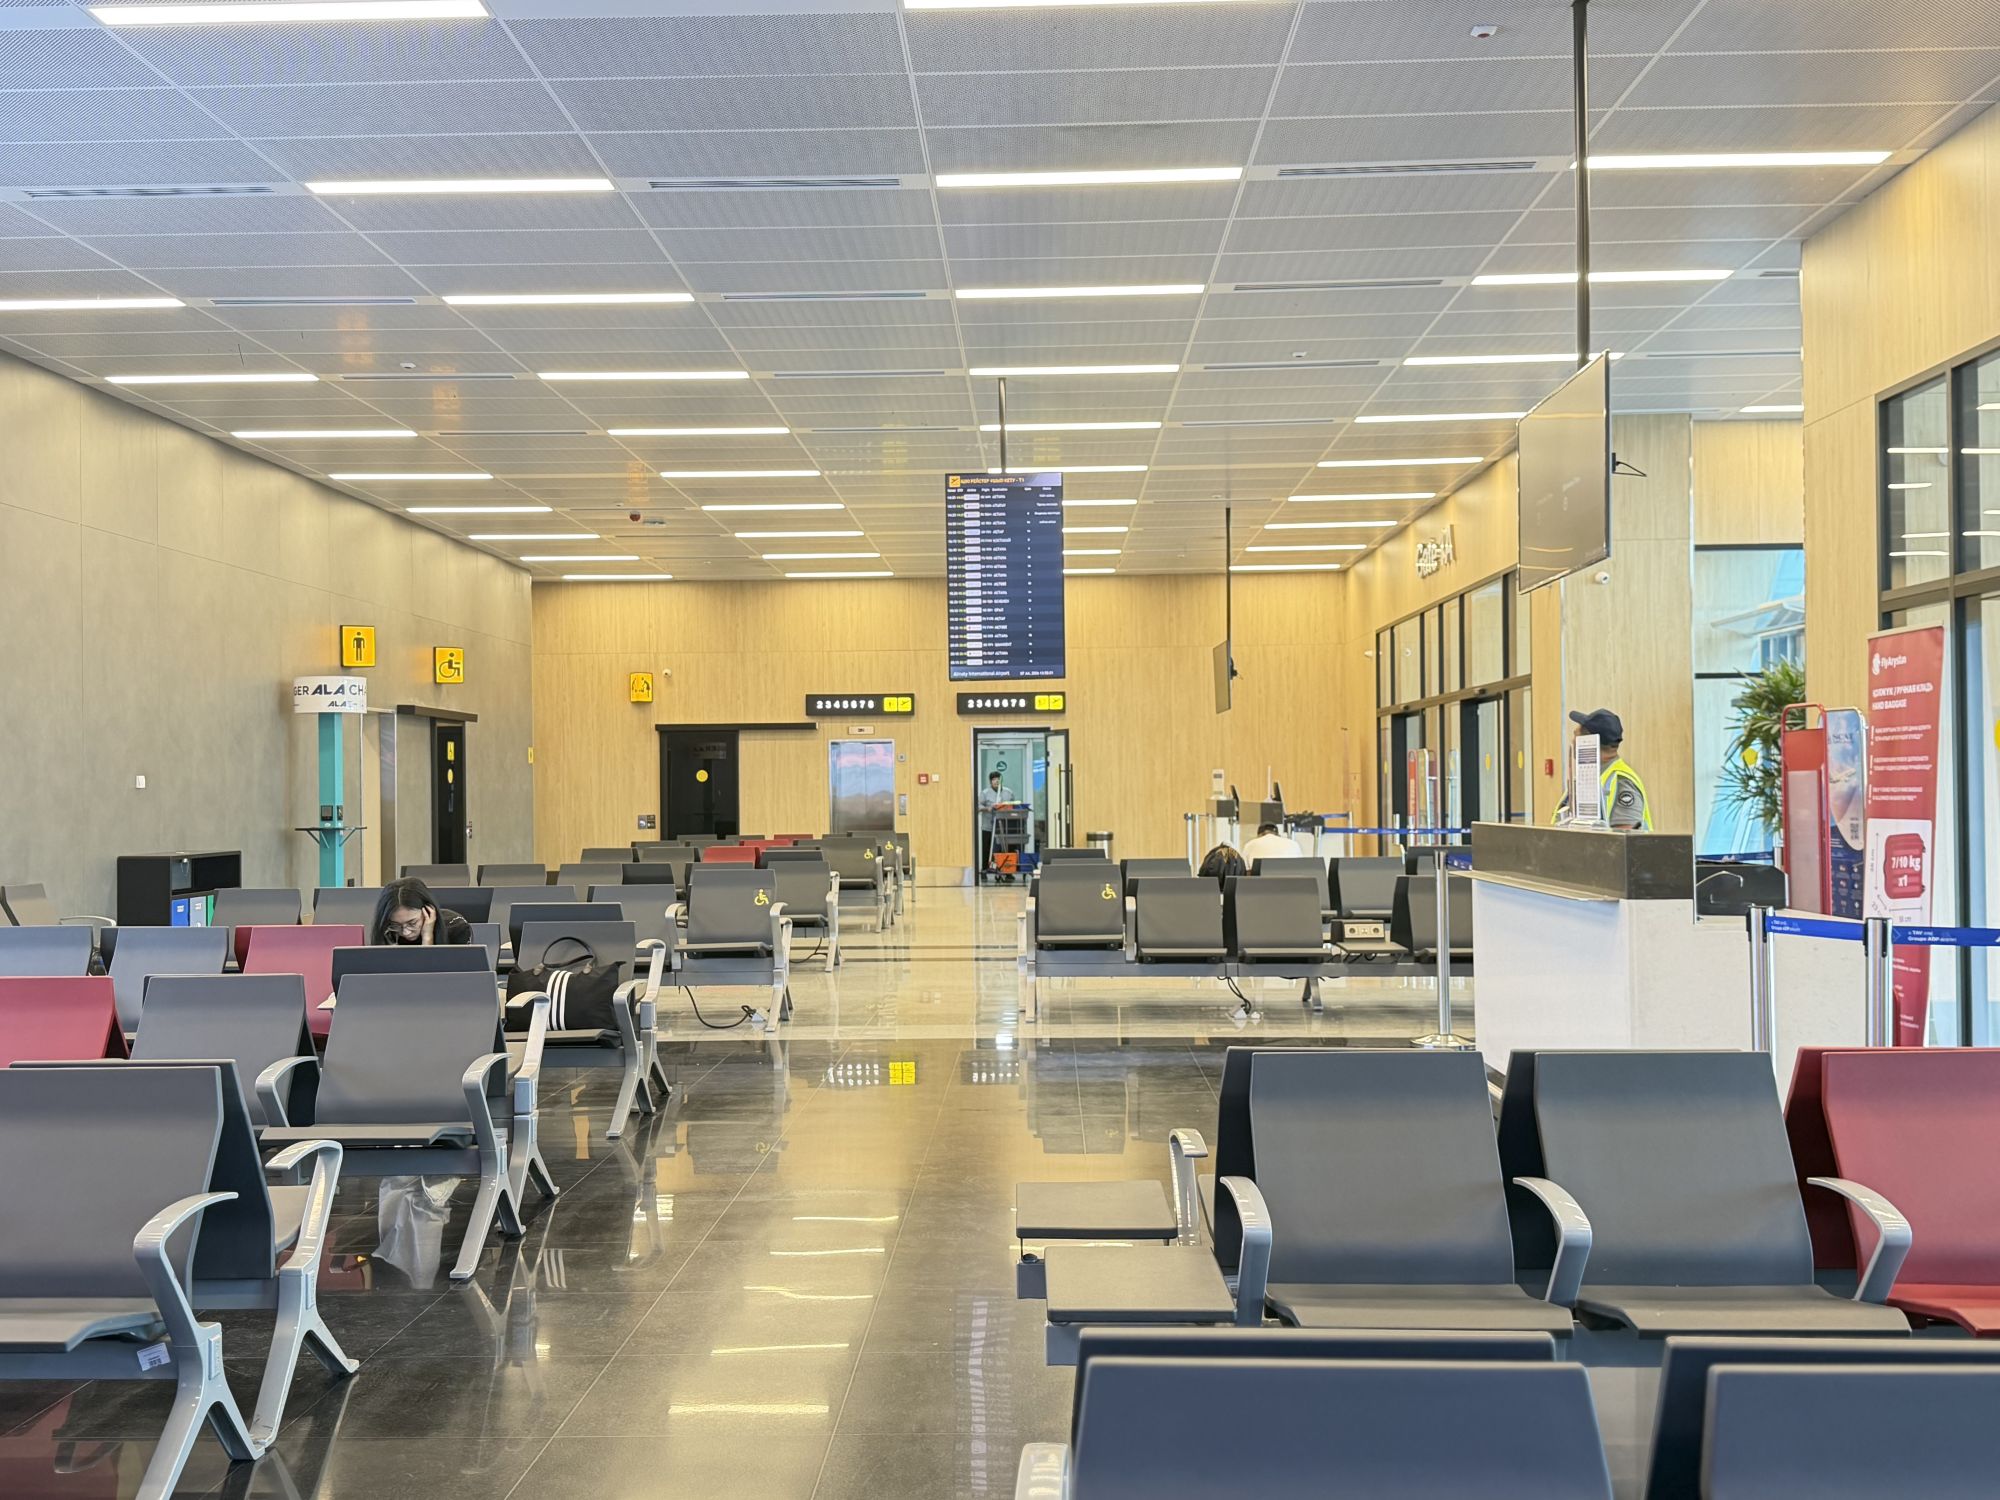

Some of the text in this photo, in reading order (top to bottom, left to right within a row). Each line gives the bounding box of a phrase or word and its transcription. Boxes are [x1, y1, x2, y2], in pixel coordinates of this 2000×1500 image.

[311, 684, 345, 695] ALA
[1891, 855, 1908, 869] 7/10
[1909, 854, 1921, 871] kg
[1898, 874, 1908, 887] x1
